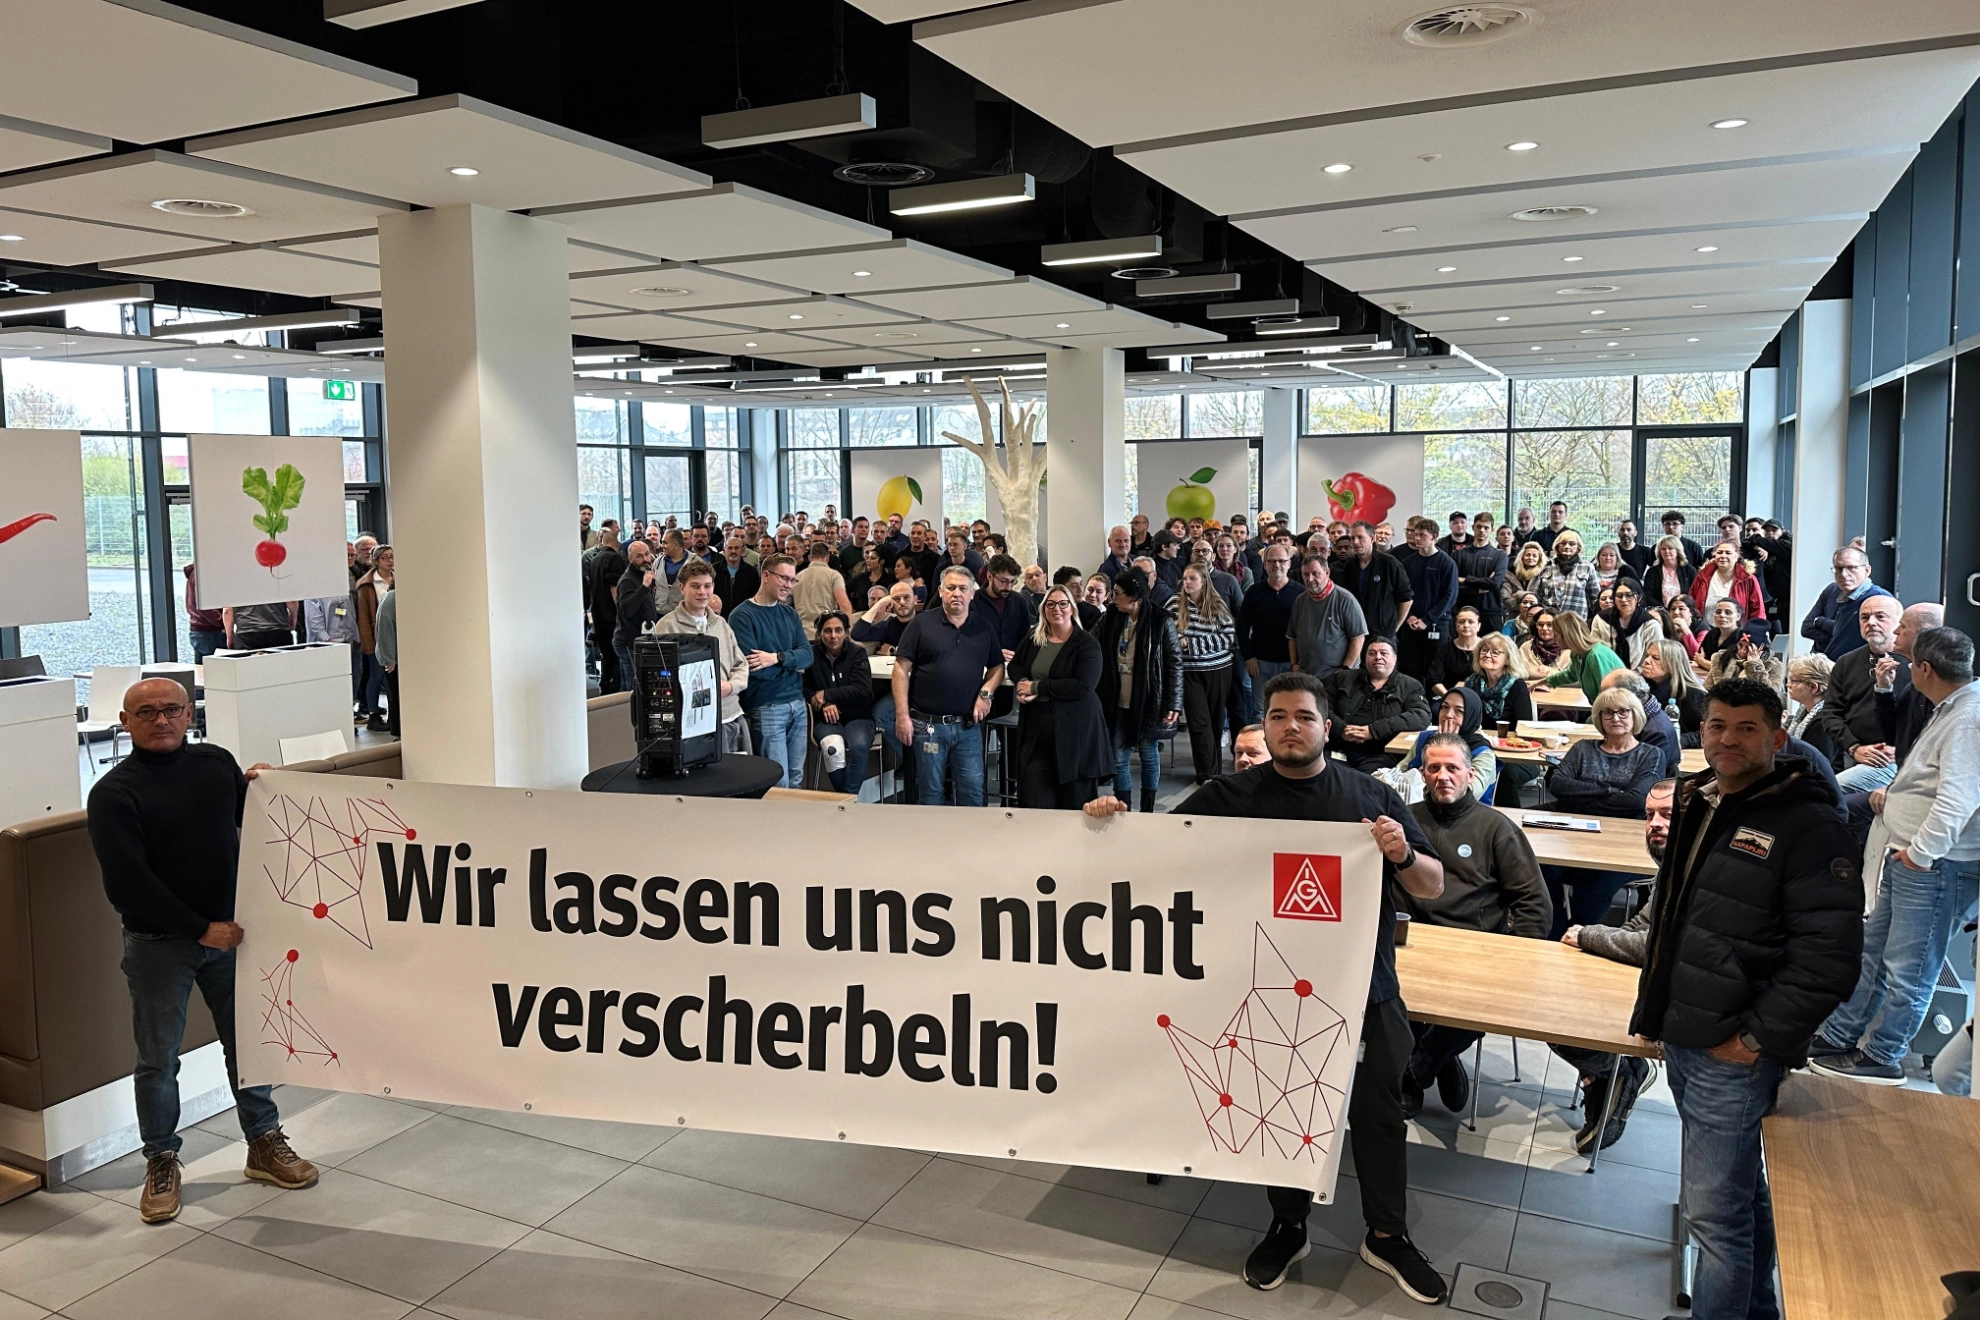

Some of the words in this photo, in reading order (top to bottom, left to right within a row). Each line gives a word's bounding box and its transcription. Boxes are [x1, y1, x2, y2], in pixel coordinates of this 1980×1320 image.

[1733, 840, 1766, 856] NAPAPIJRI
[376, 841, 508, 928] Wir
[529, 847, 780, 947] lassen
[805, 886, 956, 957] uns
[980, 875, 1205, 981] nicht
[491, 974, 1059, 1094] verscherbeln!
